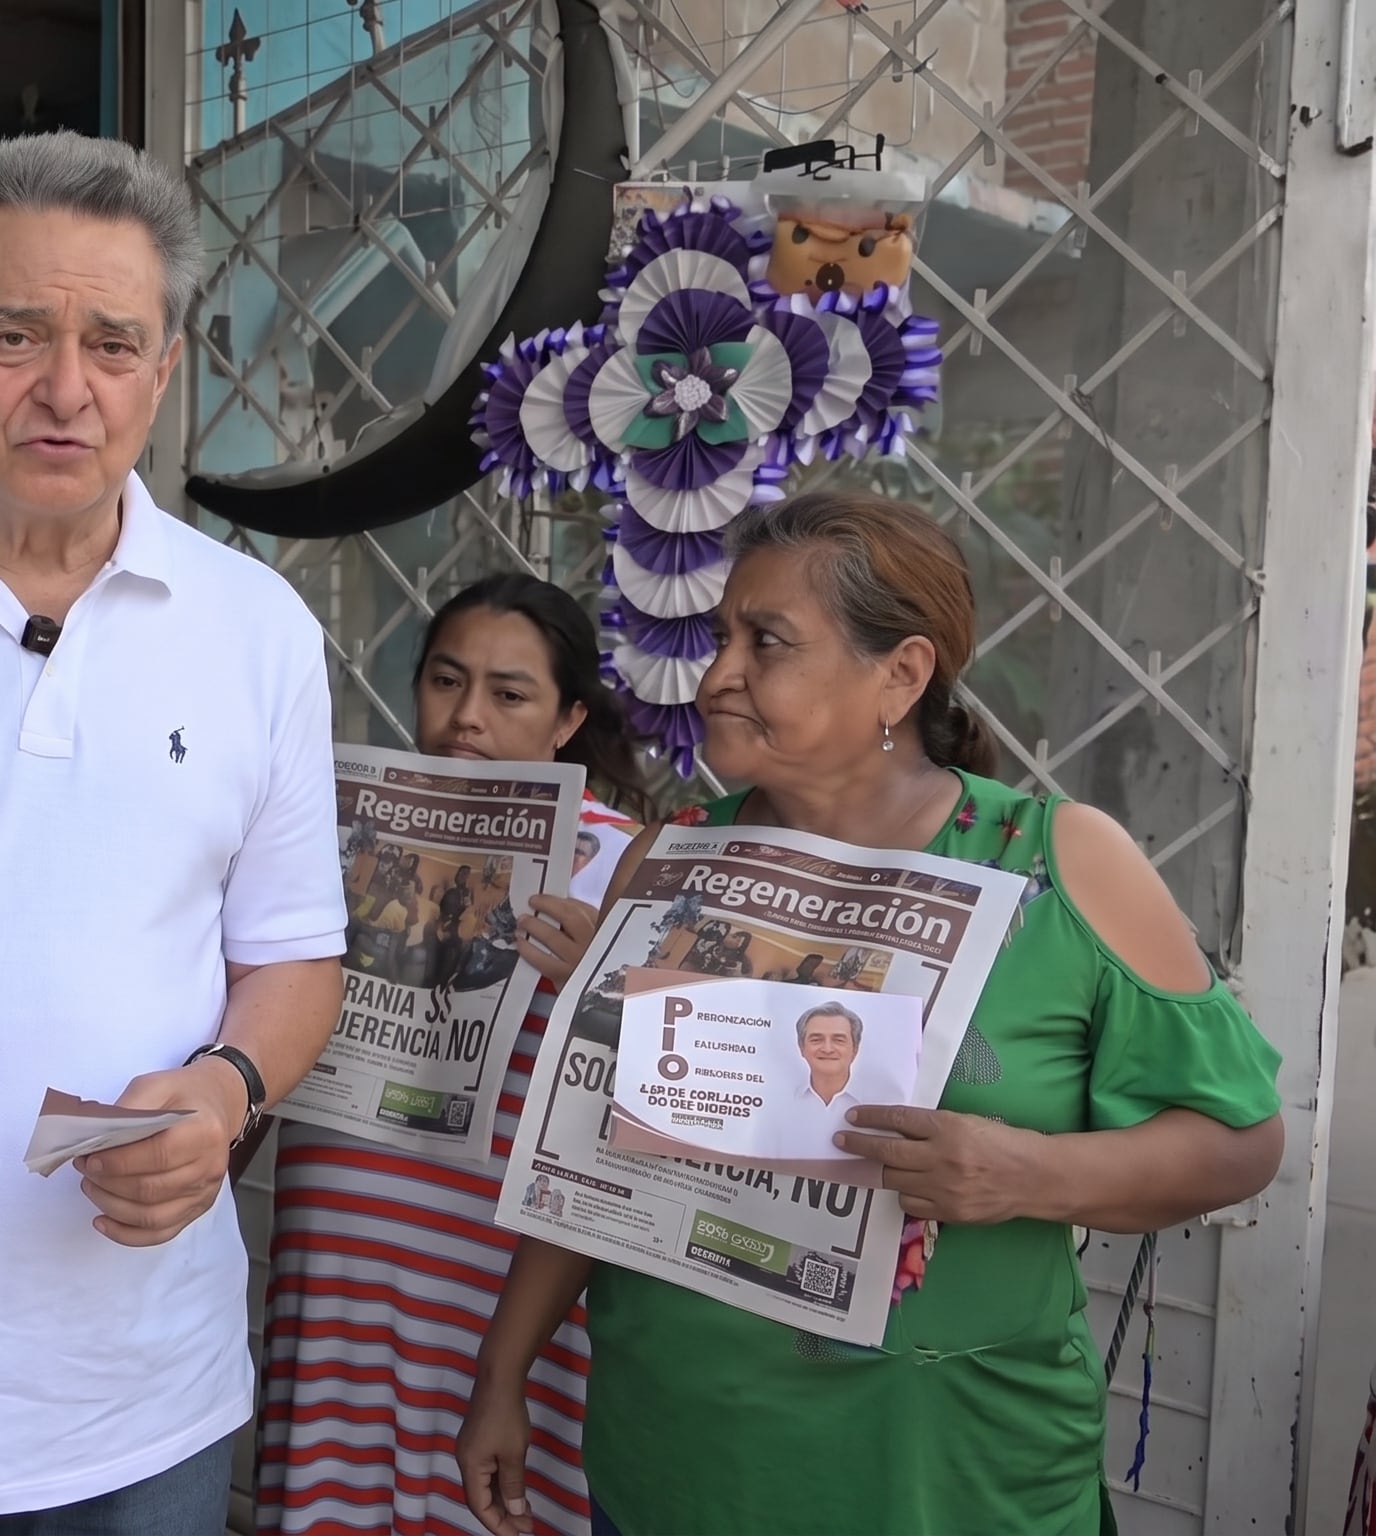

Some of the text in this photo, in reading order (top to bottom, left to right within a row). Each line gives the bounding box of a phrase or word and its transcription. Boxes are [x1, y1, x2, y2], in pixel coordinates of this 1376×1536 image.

[355, 788, 547, 840] Regeneración
[681, 863, 952, 946] Regeneración
[445, 1019, 486, 1063] NO
[745, 1073, 765, 1084] DEL
